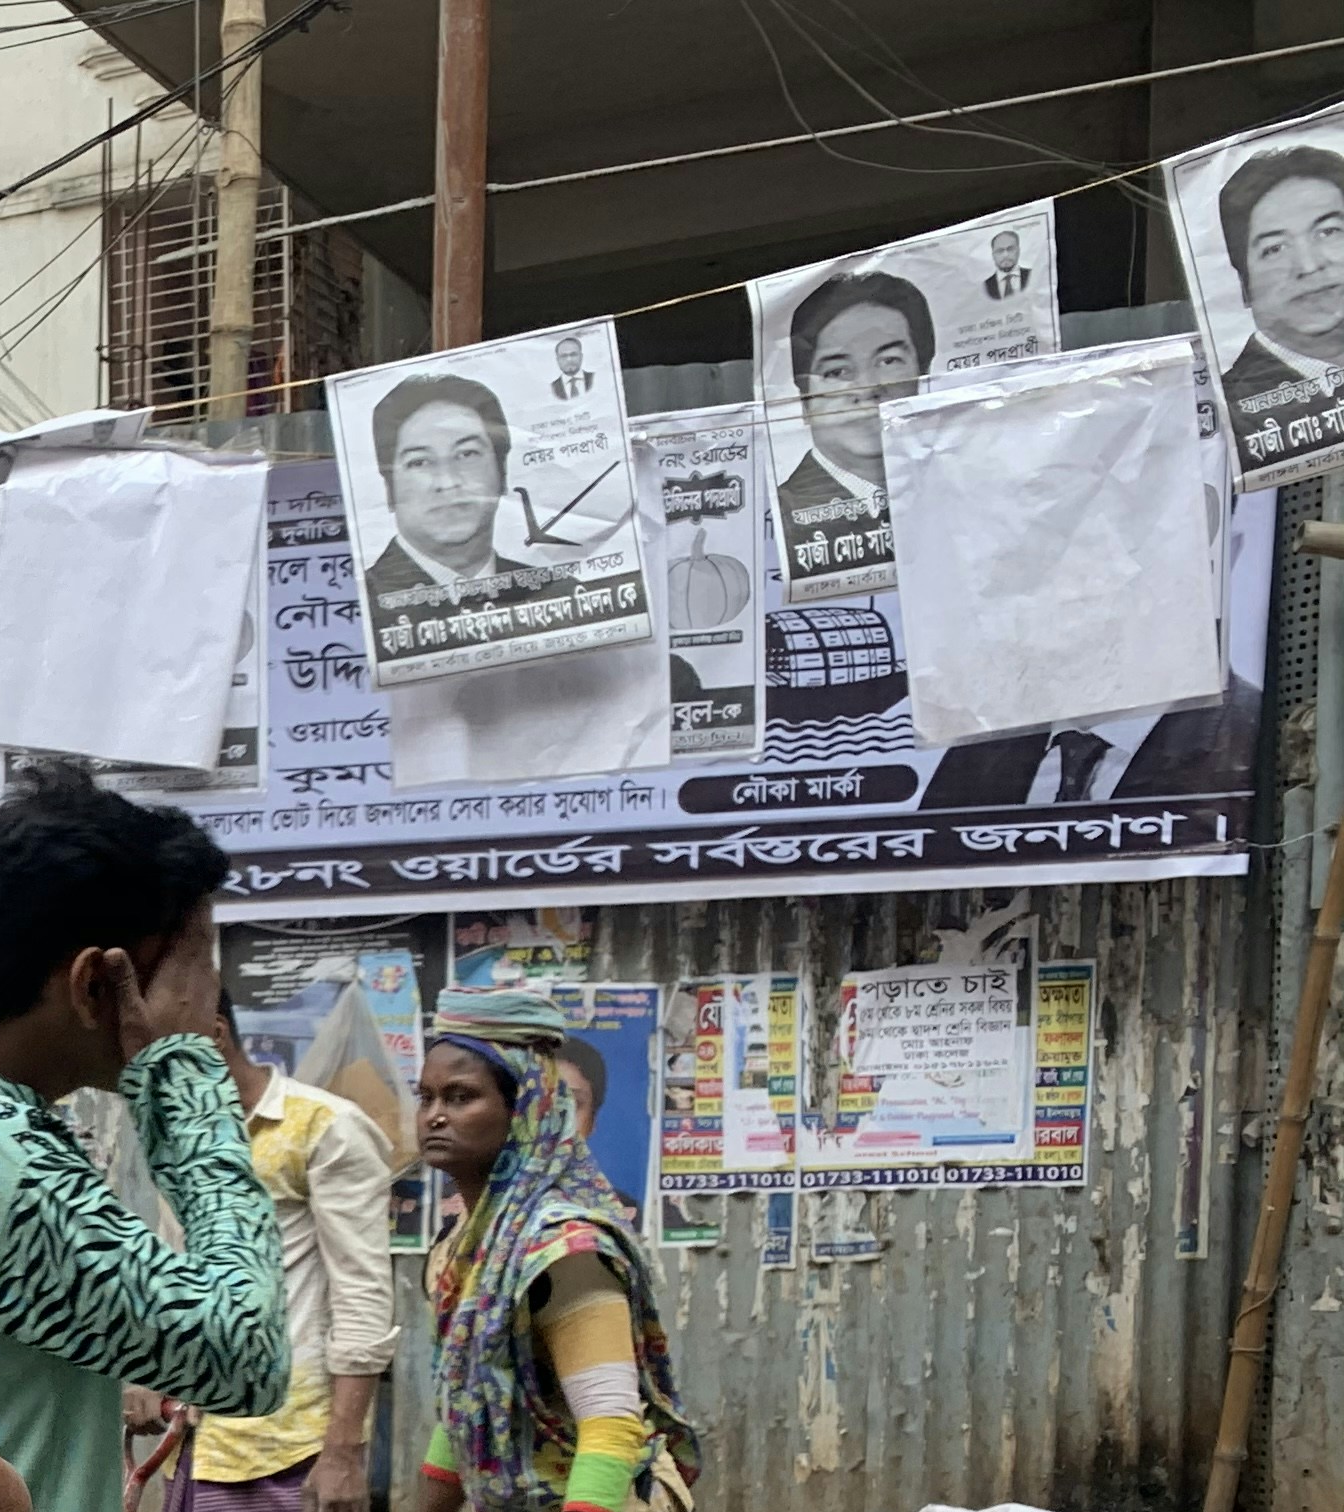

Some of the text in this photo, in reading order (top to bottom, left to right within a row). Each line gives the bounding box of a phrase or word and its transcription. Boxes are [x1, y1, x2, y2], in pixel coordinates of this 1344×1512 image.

[559, 435, 610, 461] পদপ্রার্থী
[1244, 414, 1322, 462] হাজী মোঃ
[586, 552, 625, 574] গড়তে
[793, 530, 830, 572] হাজী
[834, 531, 865, 562] মোঃ
[379, 614, 414, 655] হাজী
[417, 617, 448, 646] মোঃ
[574, 584, 614, 618] মিলন
[617, 582, 638, 609] কে
[286, 708, 392, 743] ওয়ার্ডের
[732, 768, 865, 805] নৌকা মার্কা
[270, 805, 315, 833] ভোট
[318, 801, 358, 828] দিয়ে
[448, 793, 492, 822] সেবা
[497, 792, 547, 818] করার
[552, 787, 612, 822] সুযোগ
[221, 810, 1188, 896] ২৮নং ওয়ার্ডের সর্বস্তরের জনগণ
[861, 967, 1012, 1004] পড়াতে চাই
[959, 1000, 985, 1015] সকল
[661, 1172, 796, 1190] 01733-111010
[945, 1164, 1082, 1184] 01733-111010
